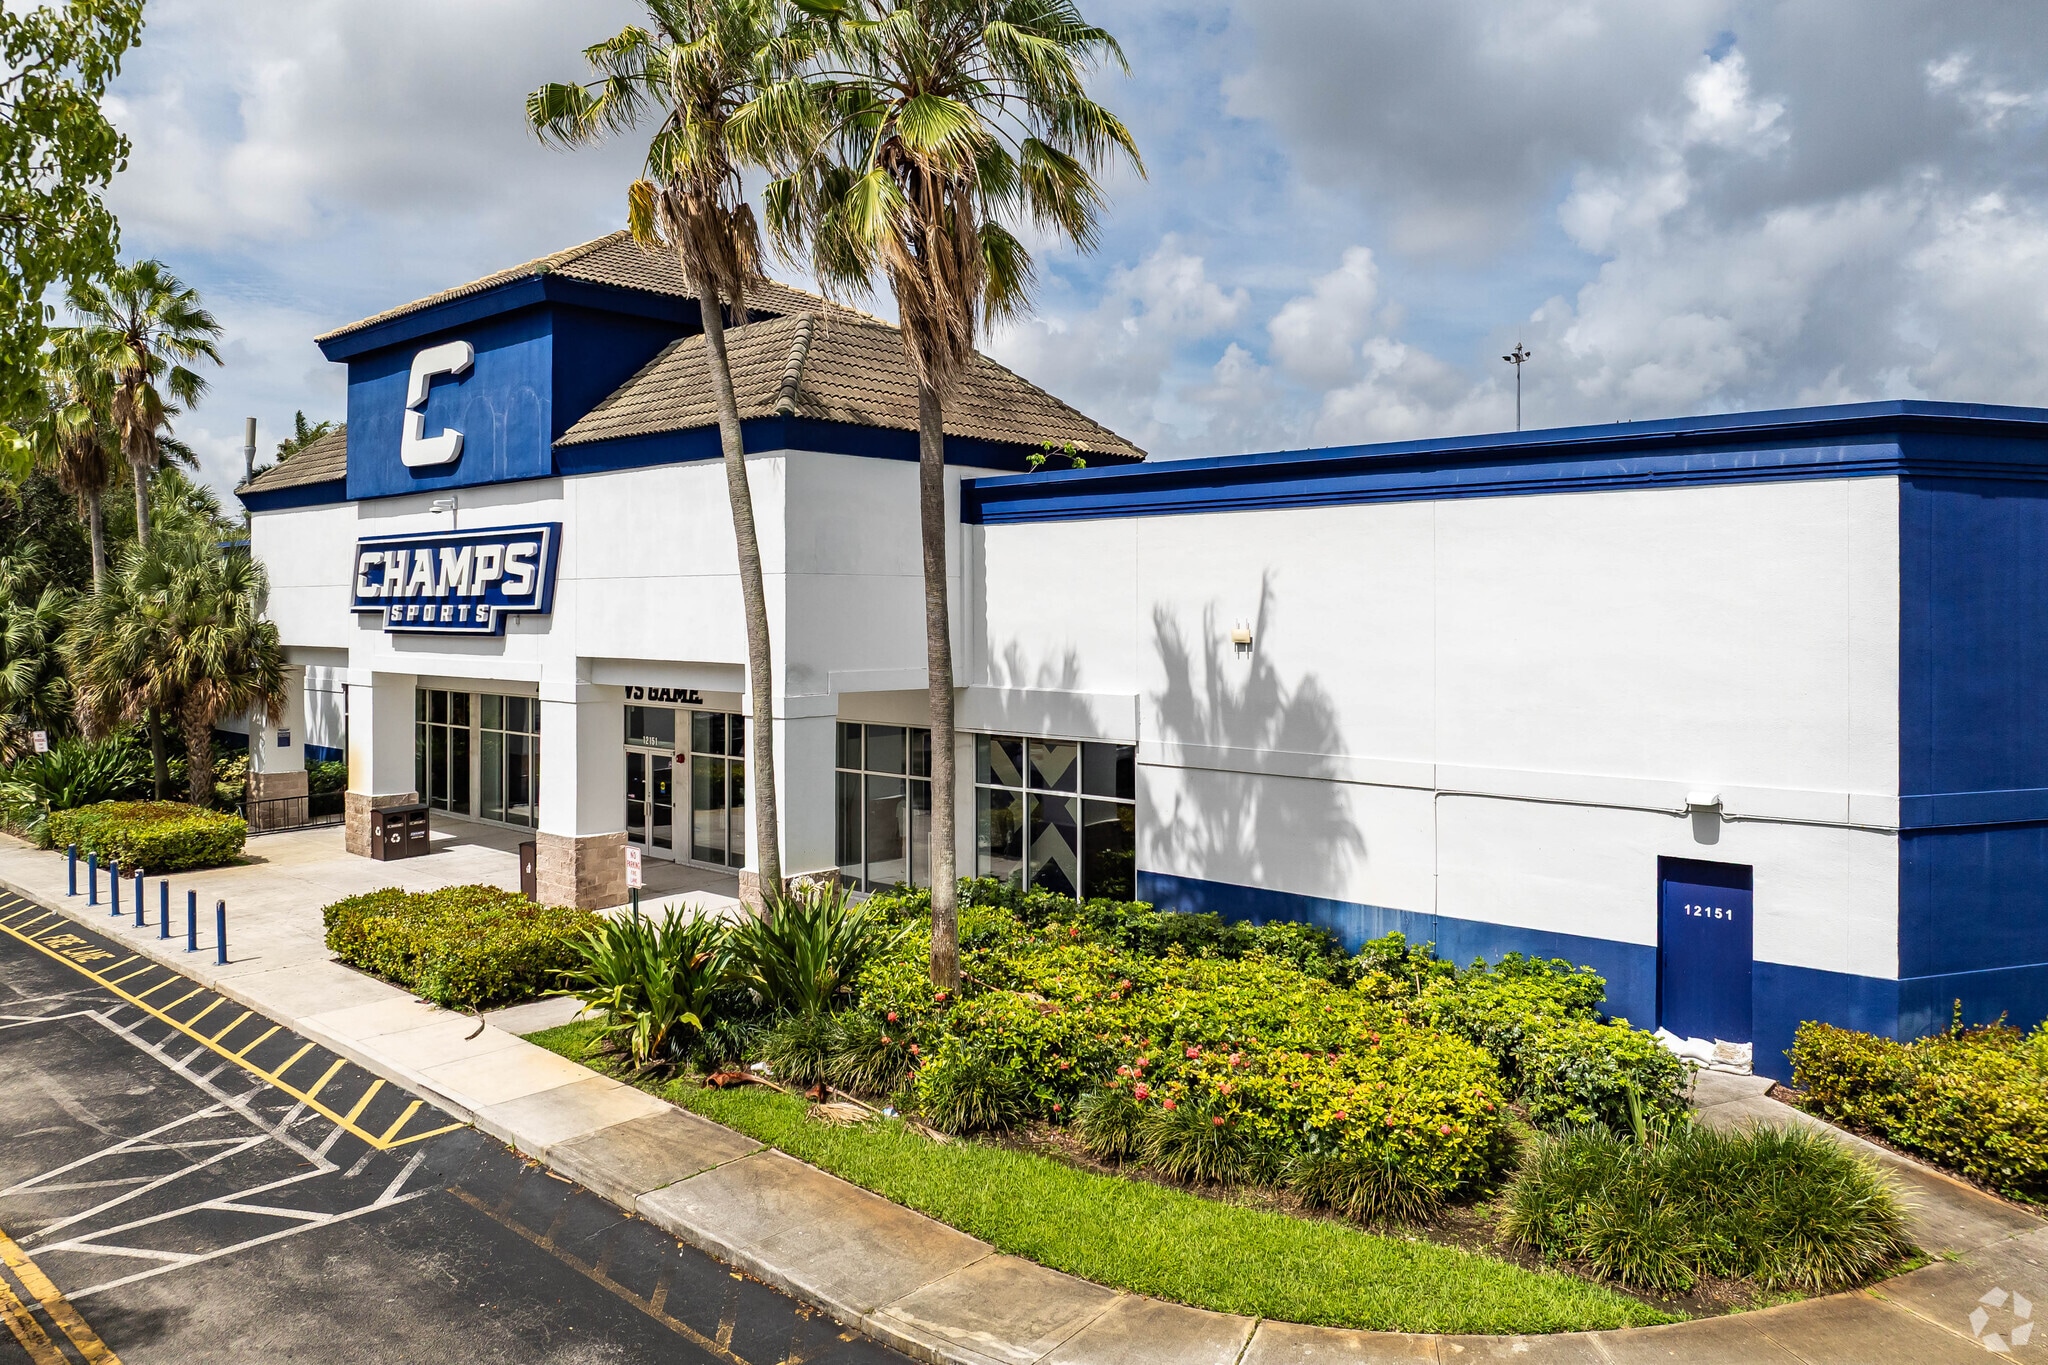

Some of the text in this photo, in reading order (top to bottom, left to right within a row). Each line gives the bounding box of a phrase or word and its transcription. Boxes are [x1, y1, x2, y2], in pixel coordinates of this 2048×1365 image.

[401, 340, 474, 467] C
[357, 542, 538, 598] CHAMPS
[391, 604, 491, 622] SPORTS
[643, 736, 658, 746] 12151
[630, 850, 637, 859] NO
[1684, 904, 1732, 920] 12151
[60, 944, 116, 963] LANE
